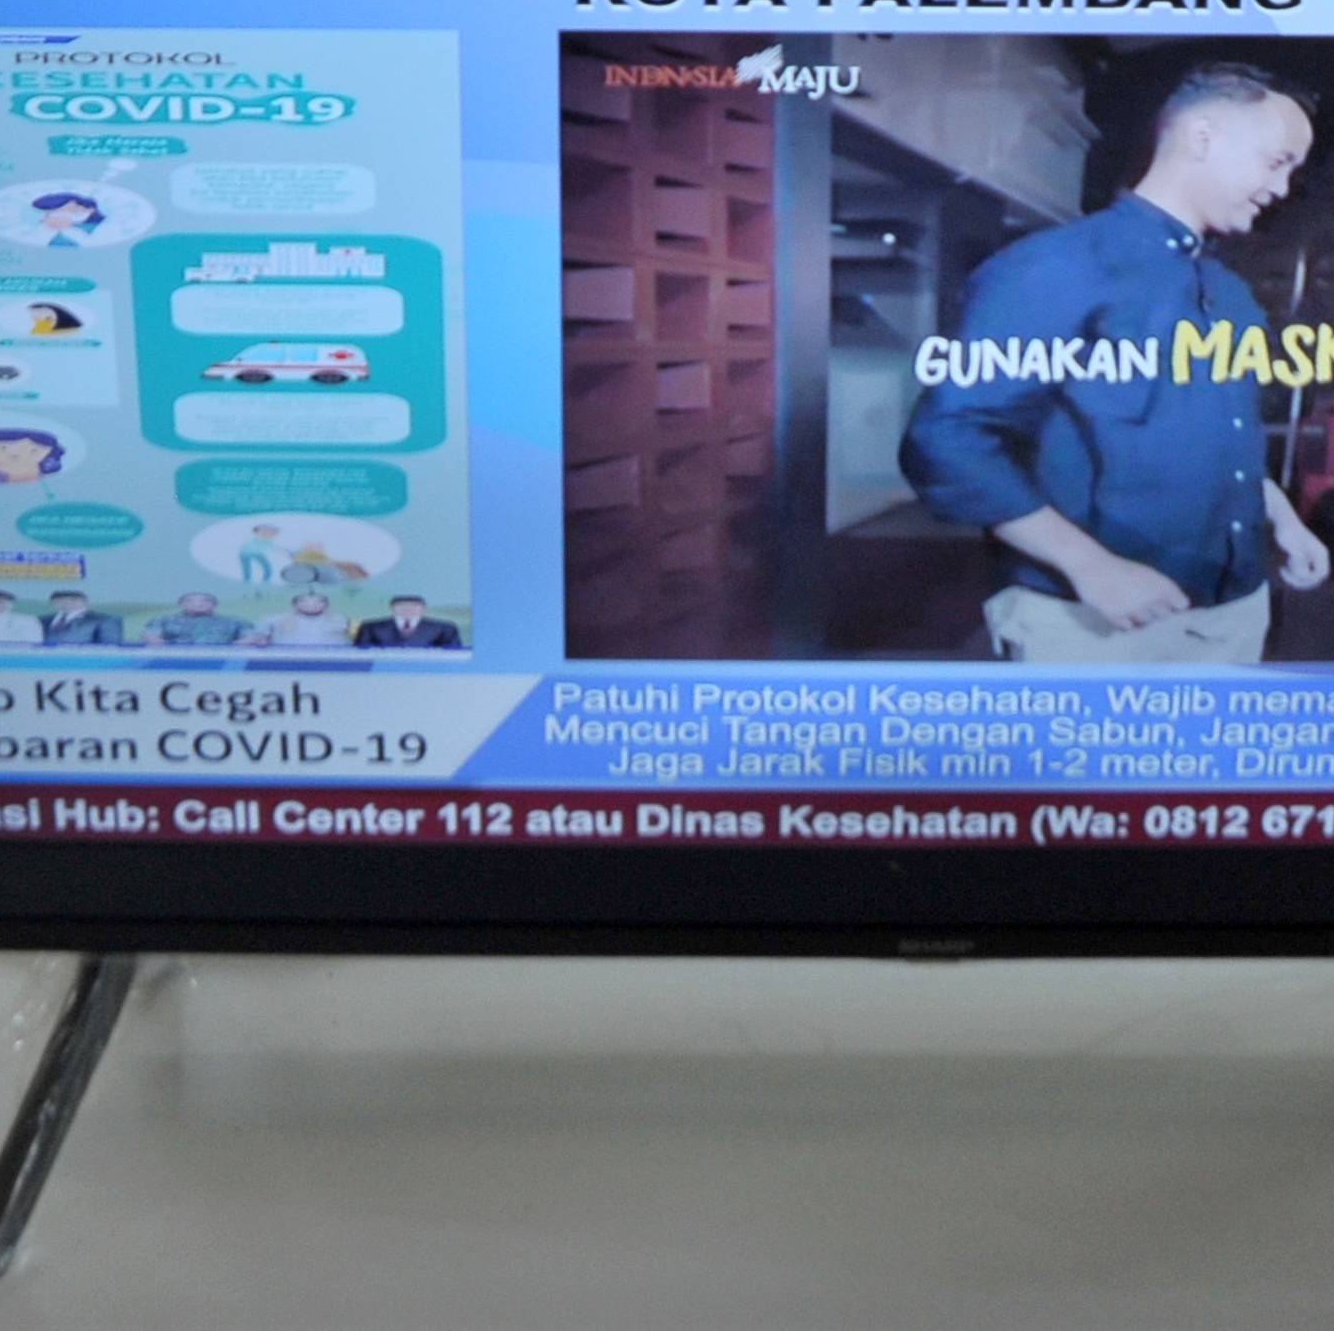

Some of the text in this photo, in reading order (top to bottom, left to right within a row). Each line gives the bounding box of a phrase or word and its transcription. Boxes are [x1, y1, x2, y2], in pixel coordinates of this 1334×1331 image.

[15, 51, 235, 66] PROTOKOL
[758, 64, 860, 100] MAJU
[24, 95, 347, 121] COVID-19
[914, 335, 1159, 387] GUNAKAN
[35, 679, 141, 715] Kita
[159, 682, 321, 722] Cegah
[553, 683, 678, 714] Patuhi
[693, 684, 856, 715] Protokol
[870, 684, 1092, 719] Kesehatan,
[1108, 684, 1215, 719] Wajib
[156, 730, 428, 764] COVID-19
[544, 714, 709, 744] Mencuci
[724, 716, 866, 751] Tangan
[881, 716, 1035, 753] Dengan
[1048, 715, 1184, 748] Sabun,
[609, 747, 703, 782] Jaga
[717, 747, 826, 777] Jarak
[839, 747, 927, 776] Fisik
[941, 748, 1012, 776] min
[1027, 748, 1087, 776] 1-2
[1101, 750, 1219, 780] meter,
[54, 797, 160, 832] Hub:
[174, 799, 262, 833] Call
[273, 801, 424, 834] Center
[437, 803, 513, 835] 112
[525, 806, 623, 837] atau
[637, 803, 764, 837] Dinas
[779, 805, 1018, 839] Kesehatan
[1031, 805, 1129, 845] (Wa:
[1144, 805, 1249, 839] 0812
